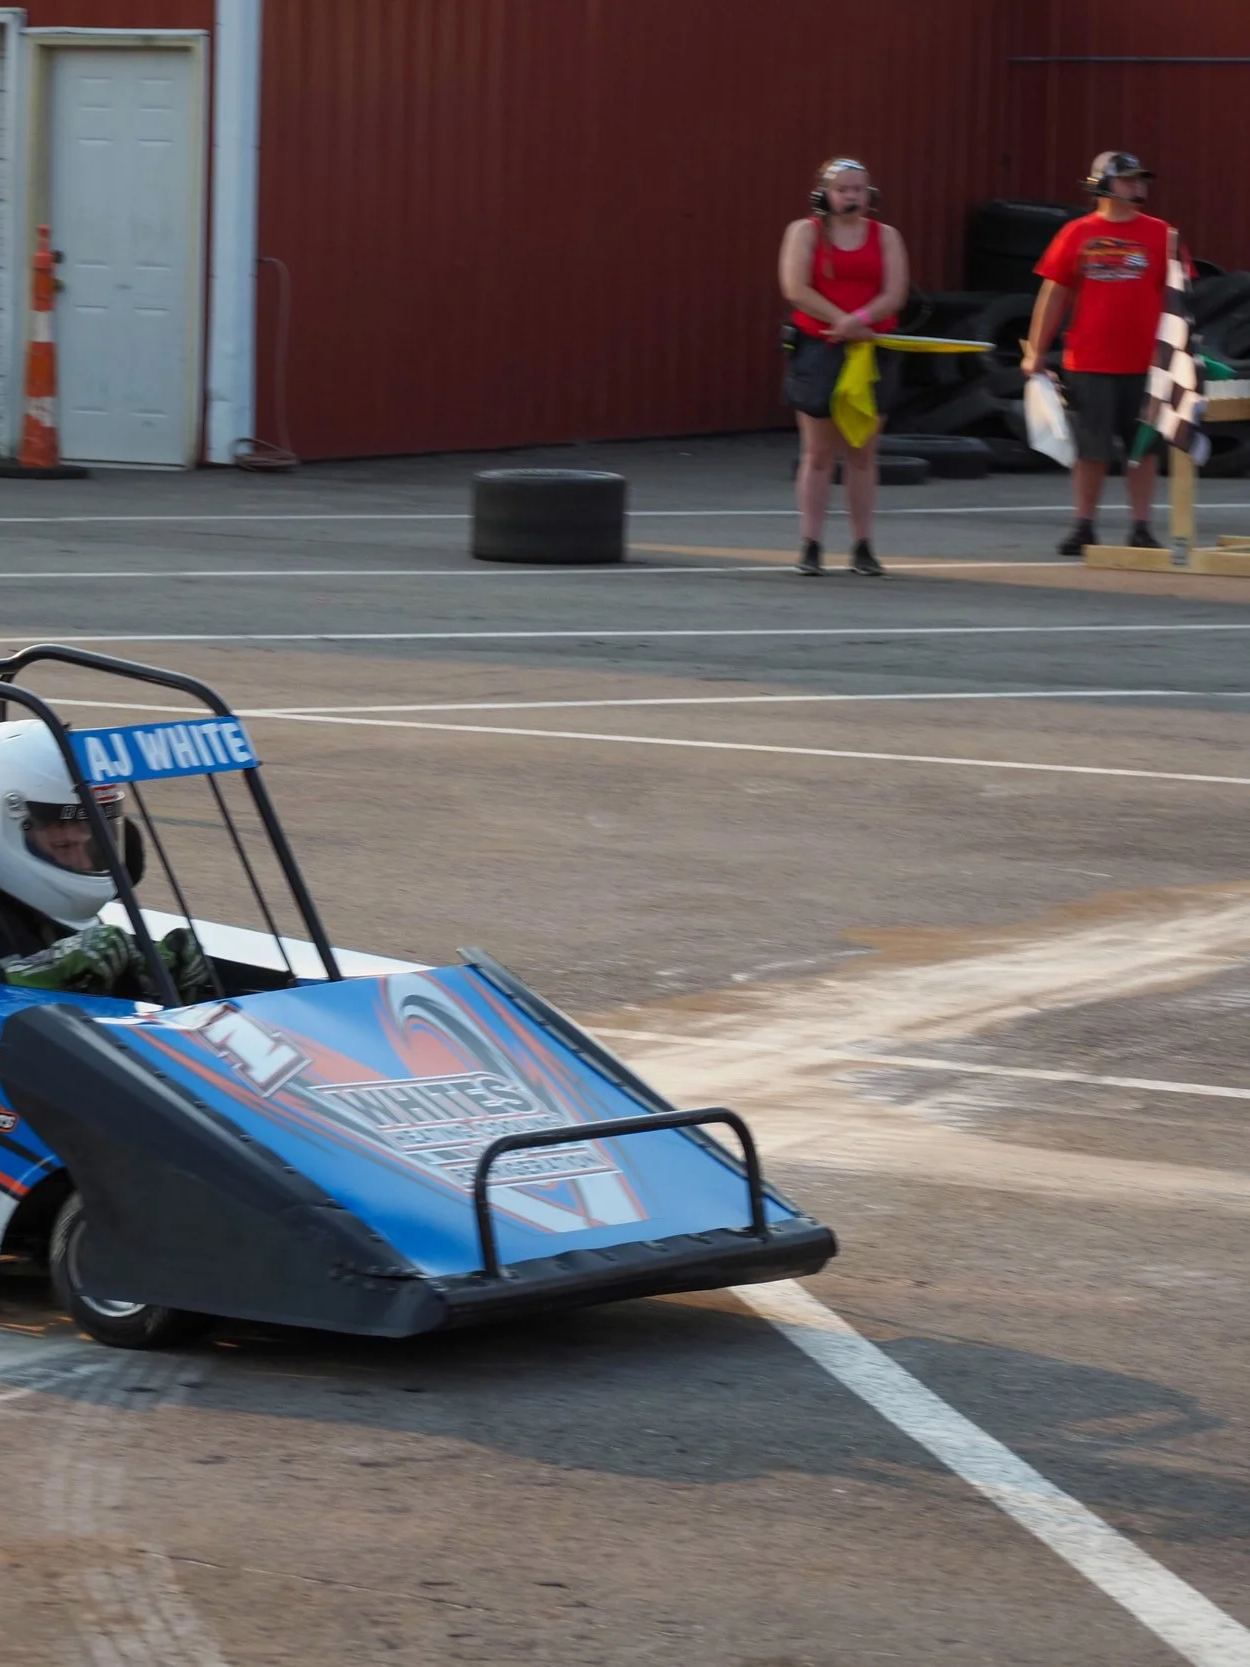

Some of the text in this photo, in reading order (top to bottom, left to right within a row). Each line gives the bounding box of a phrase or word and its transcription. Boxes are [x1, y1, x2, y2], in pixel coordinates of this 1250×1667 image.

[84, 722, 253, 782] AJ WHITE
[334, 1076, 541, 1127] WHITES
